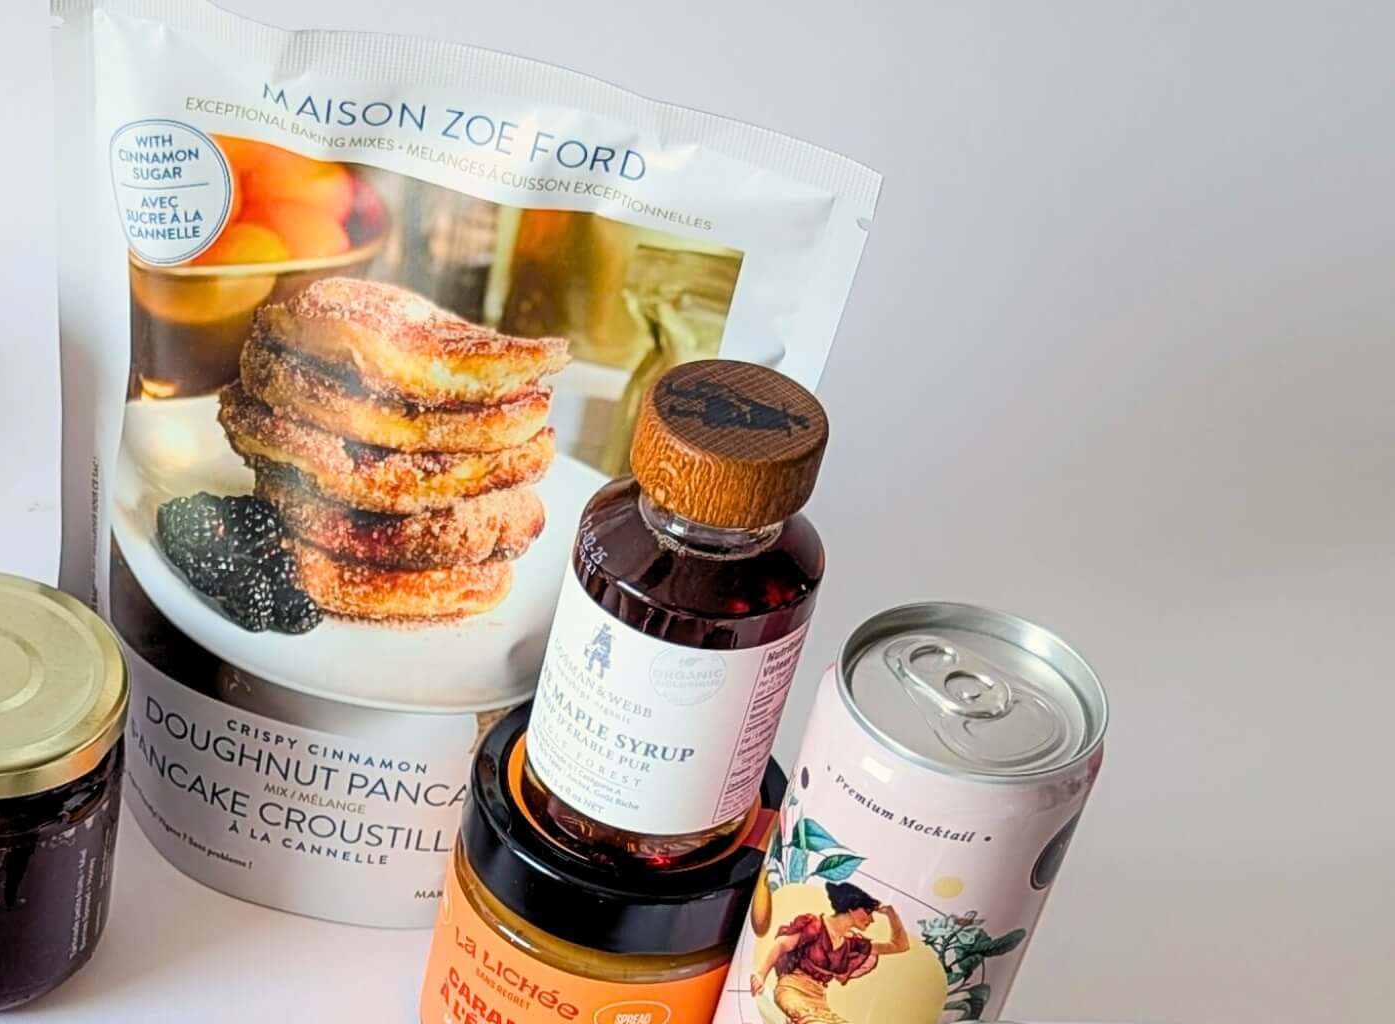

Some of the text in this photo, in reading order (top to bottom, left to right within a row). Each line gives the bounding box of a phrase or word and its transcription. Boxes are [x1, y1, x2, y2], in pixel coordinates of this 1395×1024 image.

[135, 134, 173, 148] WITH
[185, 96, 395, 151] EXCEPTIONAL BAKING MIXES
[263, 83, 646, 181] MAISON ZOE FORD
[118, 148, 199, 164] CINNAMON
[133, 166, 183, 180] SUGAR
[126, 208, 204, 225] SUCRE À LA
[141, 196, 179, 209] AVEC
[501, 171, 571, 194] CUISSON
[573, 182, 713, 232] EXCEPTIONNELLES
[129, 225, 201, 241] CANNELLE
[552, 684, 610, 741] MAPLE
[614, 733, 695, 763] SYRUP
[609, 692, 653, 719] WEBB
[146, 695, 339, 791] DOUGHNUT
[227, 719, 428, 774] CRISPY CINNAMON
[576, 752, 643, 788] FOREST
[619, 755, 652, 773] PUR
[131, 718, 250, 818] PANCAKE
[259, 802, 453, 853] CROUSTILL
[264, 783, 289, 797] MIX
[298, 791, 367, 815] MÉLANGE
[835, 774, 976, 843] Premium Mocktail
[228, 820, 390, 865] À LA CANNELLE
[476, 967, 531, 1011] SANS REGRET
